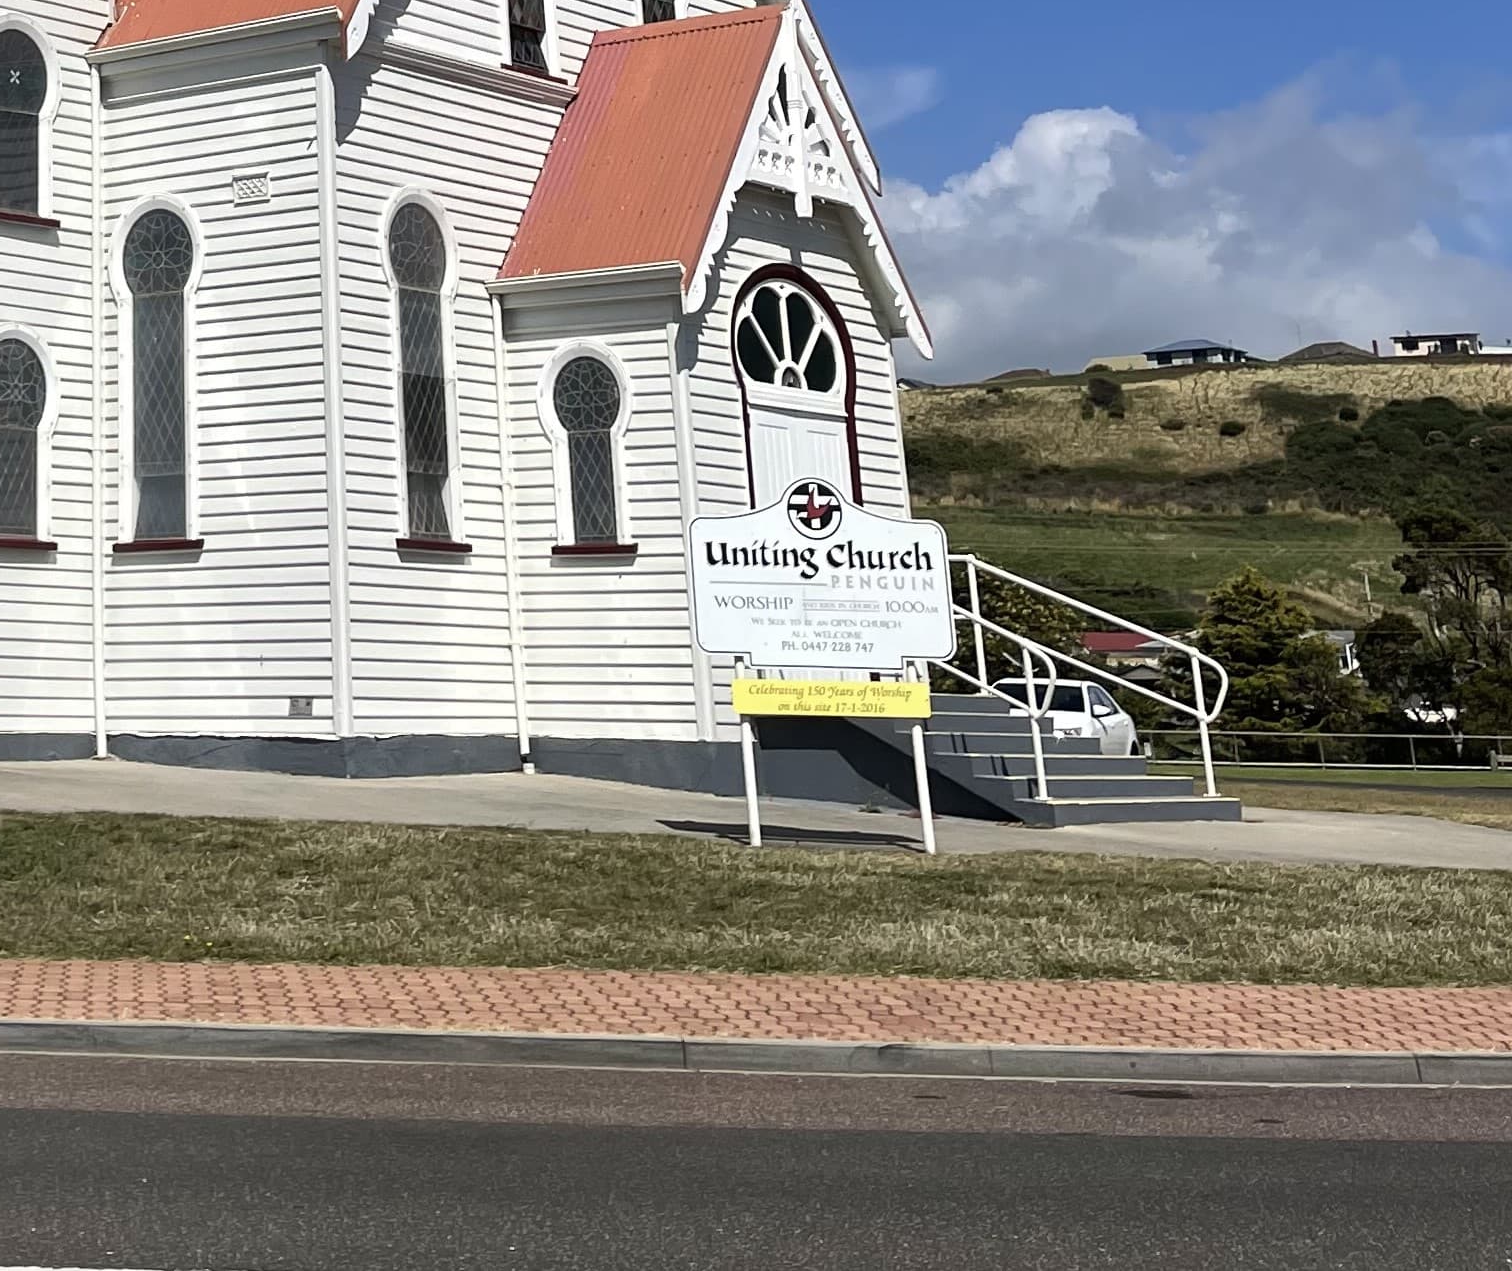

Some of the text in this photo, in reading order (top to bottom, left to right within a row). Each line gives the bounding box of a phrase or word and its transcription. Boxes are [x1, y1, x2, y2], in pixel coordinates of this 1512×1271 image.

[704, 538, 935, 580] Uniting Church
[831, 574, 934, 591] PENGUIN
[714, 595, 794, 610] WORSHIP
[830, 618, 858, 628] OPEN
[813, 630, 862, 640] WELCOME
[801, 641, 828, 652] 0447
[831, 641, 851, 652] 228
[854, 642, 874, 653] 747
[748, 684, 912, 702] Celebrating 150 Years of Worship
[793, 700, 812, 712] this
[835, 702, 885, 713] 17-1-2016
